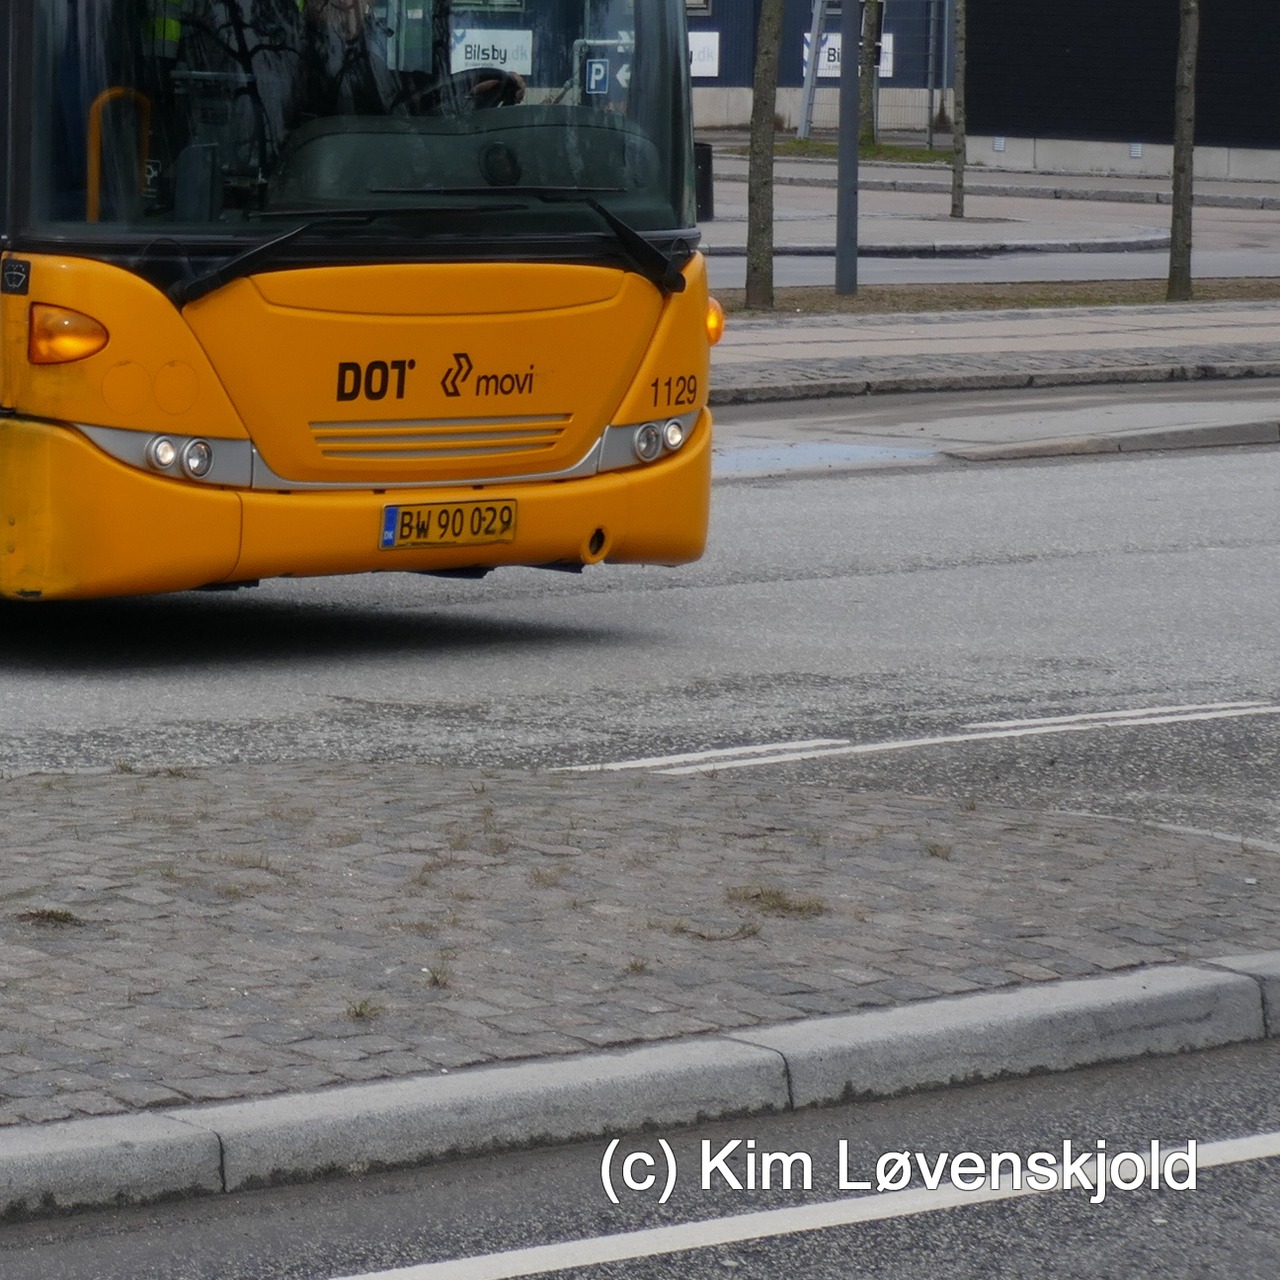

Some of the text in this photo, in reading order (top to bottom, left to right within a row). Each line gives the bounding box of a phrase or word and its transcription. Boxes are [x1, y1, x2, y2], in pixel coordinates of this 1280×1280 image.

[590, 63, 605, 90] P
[336, 359, 535, 402] DOT movi
[650, 373, 698, 408] 1129
[399, 505, 513, 540] BW 90 029
